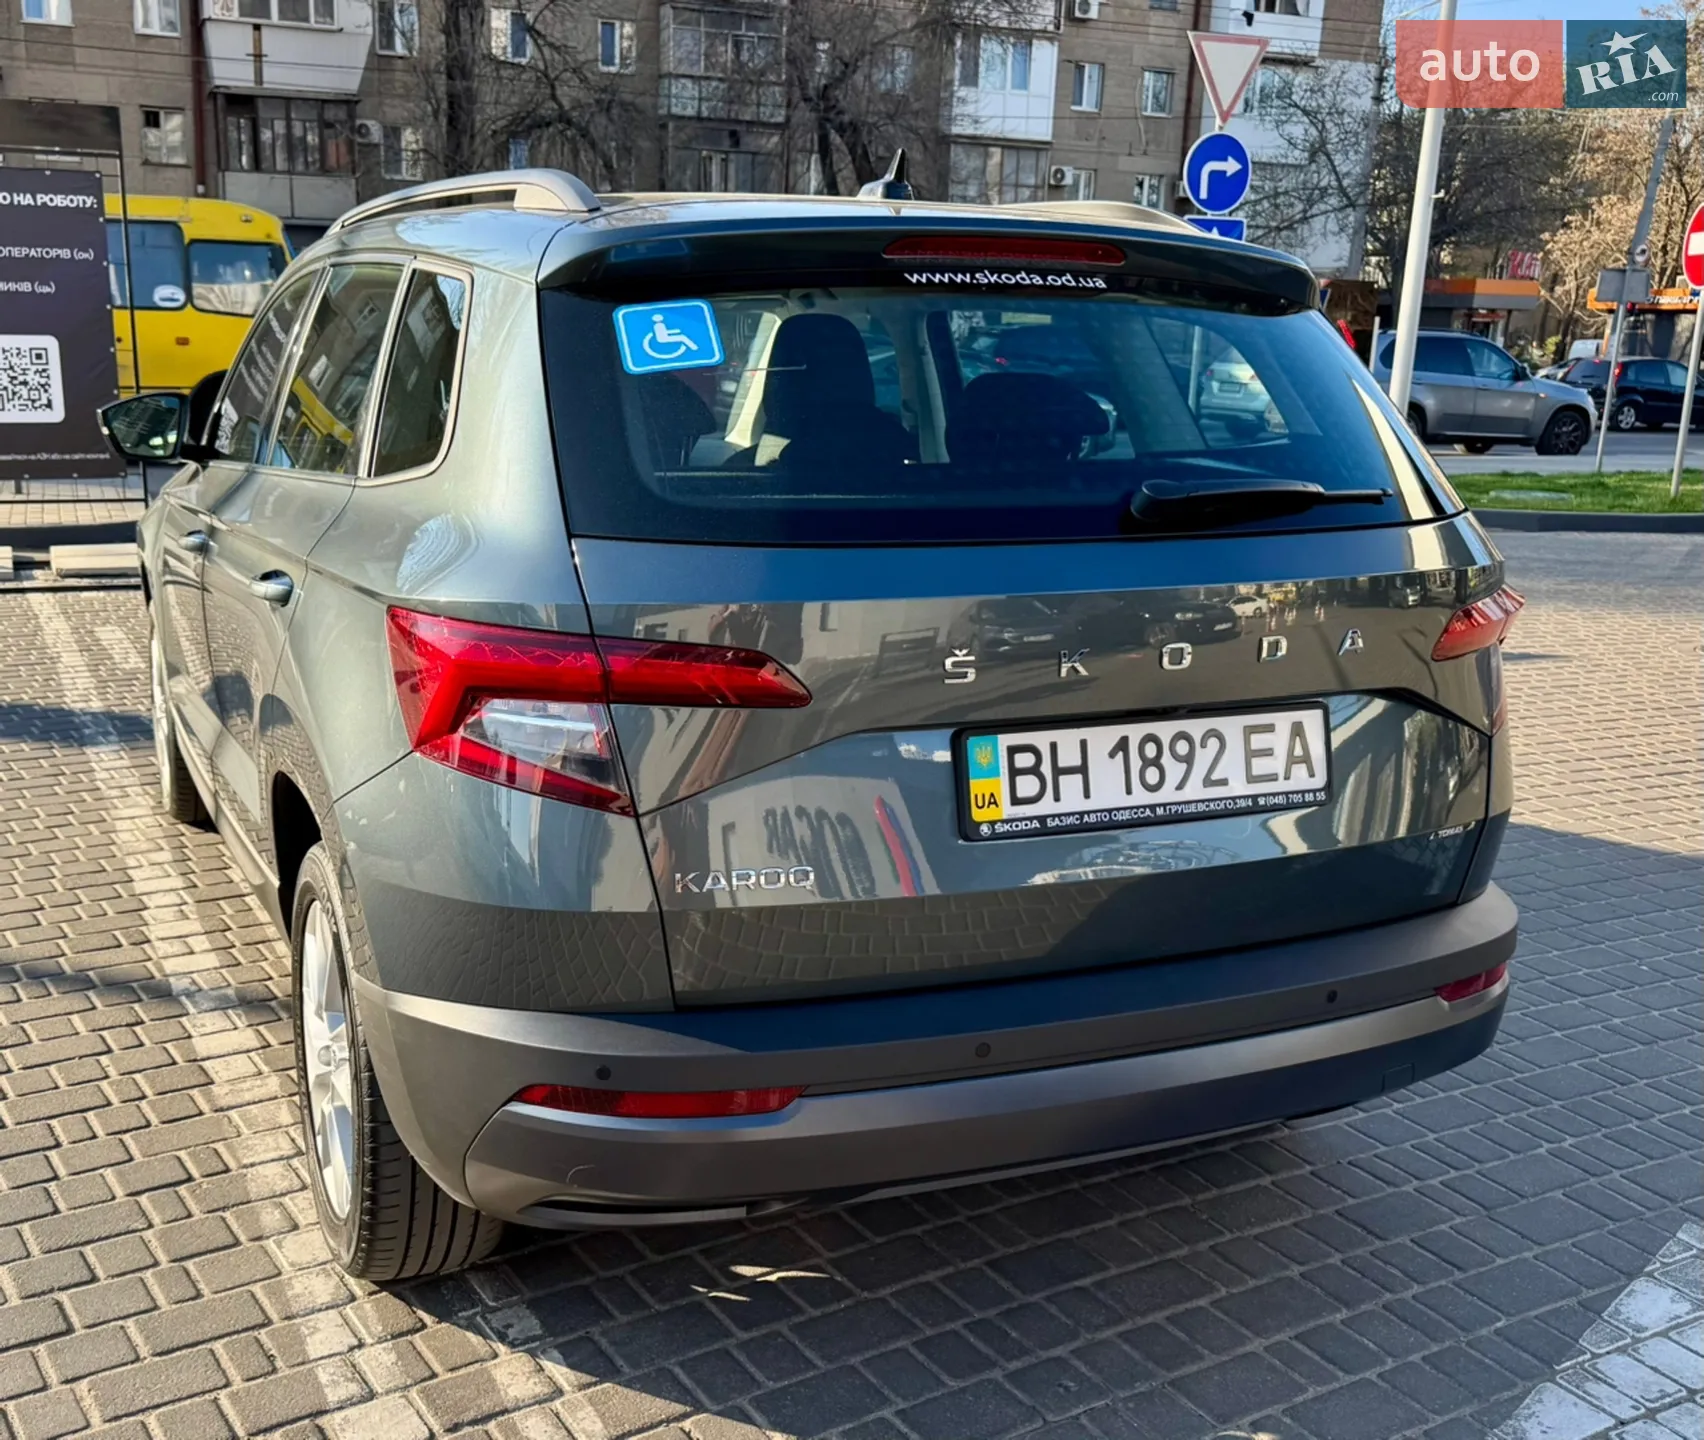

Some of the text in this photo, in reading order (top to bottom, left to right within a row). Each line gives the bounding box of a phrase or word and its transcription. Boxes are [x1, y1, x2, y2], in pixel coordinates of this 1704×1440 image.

[13, 192, 35, 206] НА
[36, 193, 98, 209] РОБОТУ:
[903, 270, 1108, 289] www.skoda.od.ua
[1006, 721, 1316, 807] BH 1892 EA
[974, 792, 999, 810] UA
[994, 819, 1041, 833] ŠKODA
[1047, 815, 1080, 827] БАЗИС
[1083, 812, 1109, 823] АВТО
[1111, 808, 1154, 820] ОДЕССА,
[1288, 793, 1302, 803] 705
[1304, 792, 1314, 802] 88
[1316, 791, 1326, 801] 55
[674, 866, 816, 893] KAROQ
